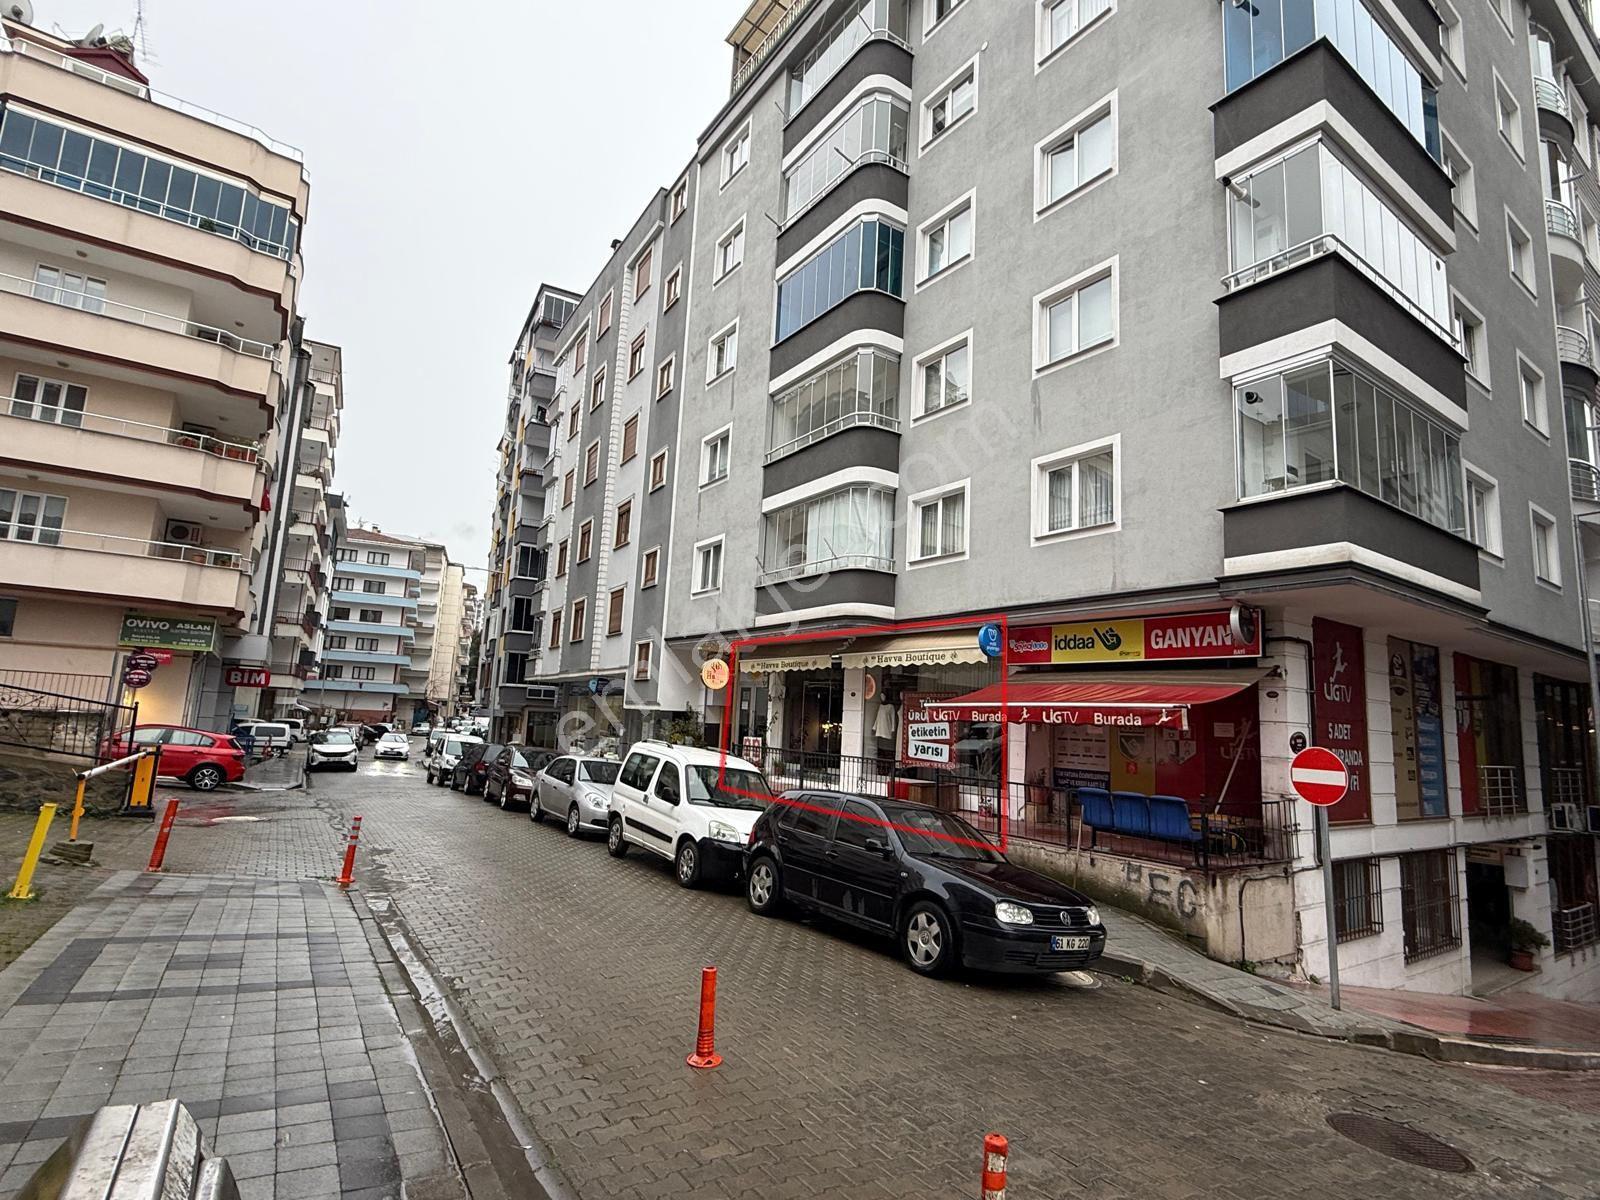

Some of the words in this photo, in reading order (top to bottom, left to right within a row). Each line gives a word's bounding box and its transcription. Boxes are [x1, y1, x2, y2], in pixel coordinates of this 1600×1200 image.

[126, 618, 170, 631] OVIVO
[176, 622, 211, 632] ASLAN
[1054, 634, 1095, 650] iddaa
[1150, 624, 1232, 649] GANYAN
[761, 661, 779, 669] Havva
[780, 659, 809, 669] Boutique
[877, 655, 903, 663] Havva
[905, 652, 946, 663] Boutique
[908, 709, 928, 721] ÜRÜ
[971, 710, 1007, 722] Burada
[1093, 712, 1142, 726] Burada
[911, 726, 947, 738] etiketin
[1334, 723, 1352, 740] ADET
[914, 743, 943, 757] yarısı
[1331, 748, 1364, 767] RANDA
[1056, 938, 1063, 949] 61
[1066, 938, 1075, 949] KG
